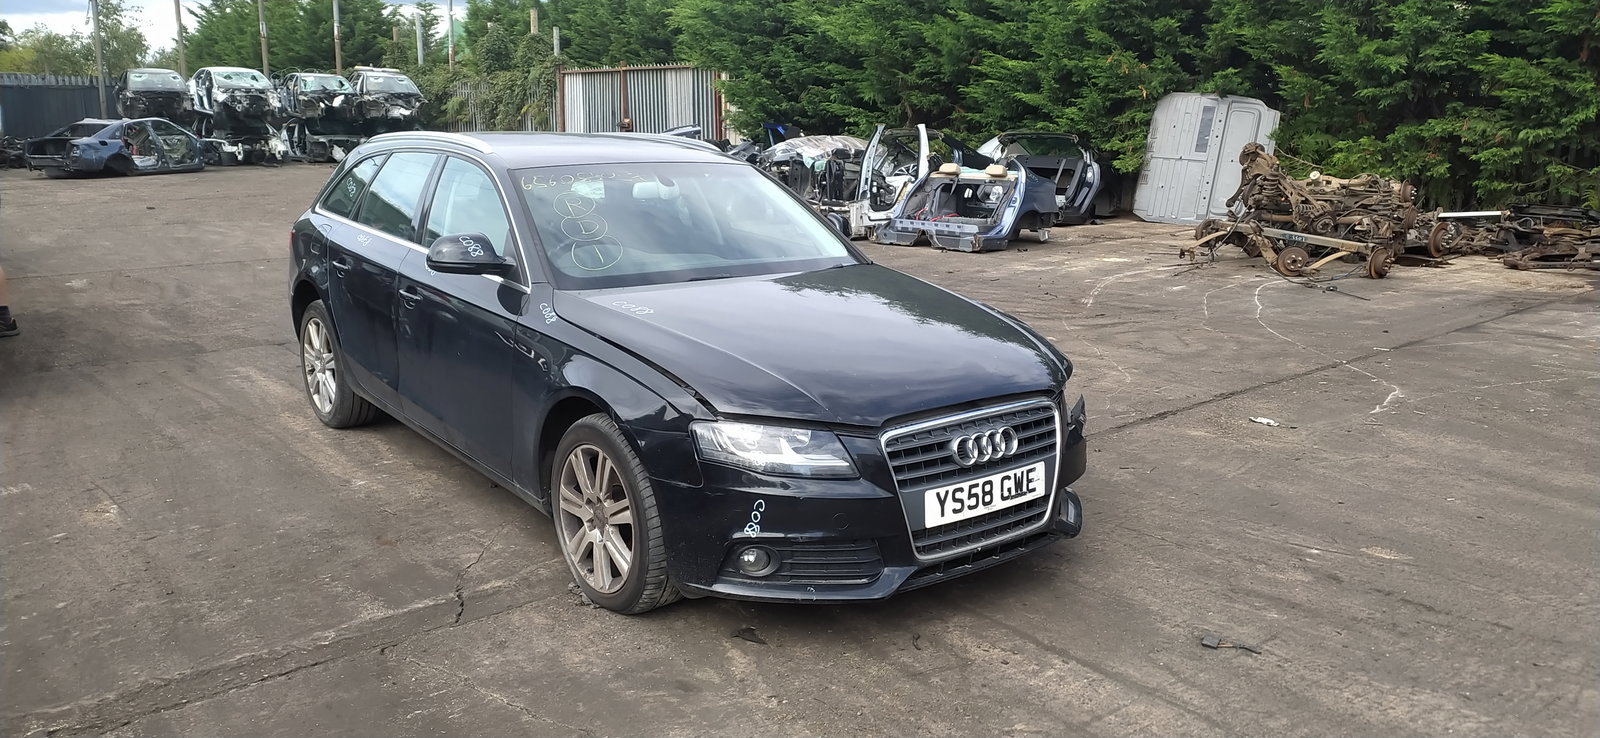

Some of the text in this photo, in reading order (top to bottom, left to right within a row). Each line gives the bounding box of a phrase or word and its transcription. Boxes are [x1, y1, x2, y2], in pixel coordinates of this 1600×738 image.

[565, 197, 587, 217] R
[576, 219, 599, 234] D
[459, 235, 484, 257] C088
[935, 466, 1037, 518] YS58 GWE
